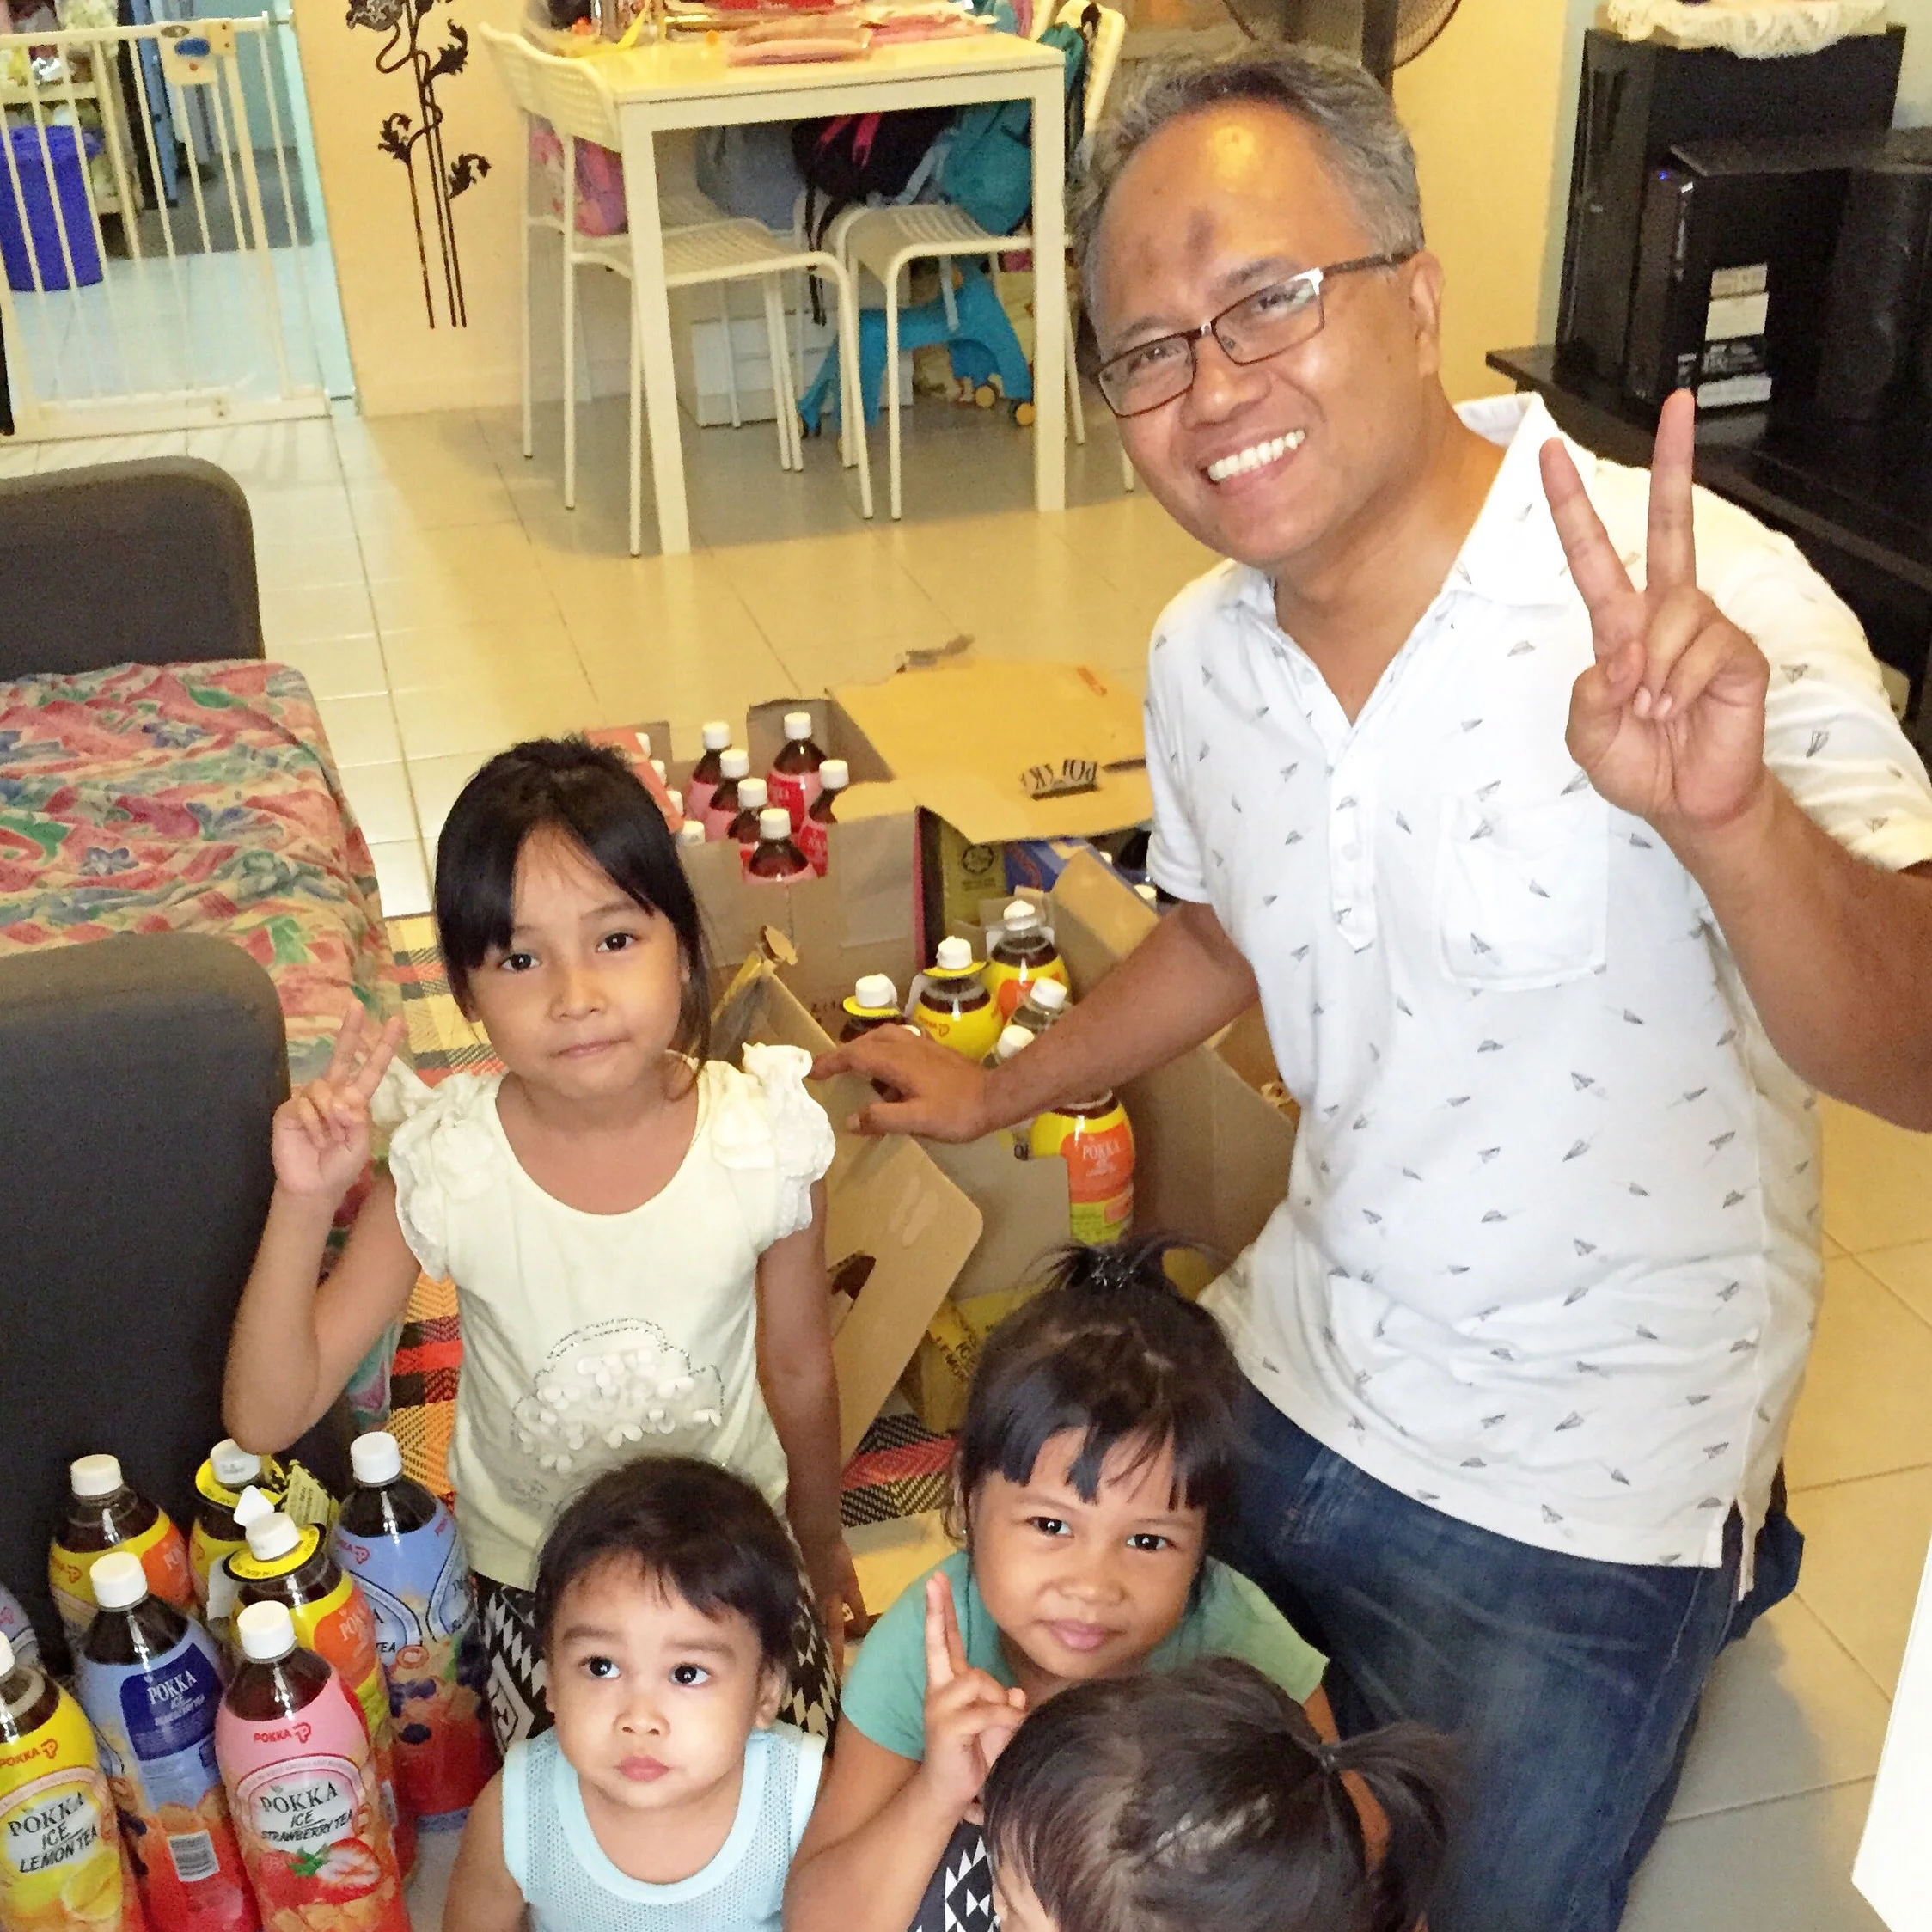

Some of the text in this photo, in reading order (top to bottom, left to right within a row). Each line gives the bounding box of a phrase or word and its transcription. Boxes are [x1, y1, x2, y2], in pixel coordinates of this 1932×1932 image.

[146, 1670, 198, 1706] POKKA
[253, 1728, 292, 1743] POKKA
[260, 1781, 339, 1813] POKKA
[8, 1791, 84, 1837] POKKA
[261, 1808, 353, 1843] STRAWBERRY TEA
[290, 1810, 315, 1828] ICE
[19, 1823, 99, 1874] LEMON TEA
[41, 1820, 71, 1850] ICE
